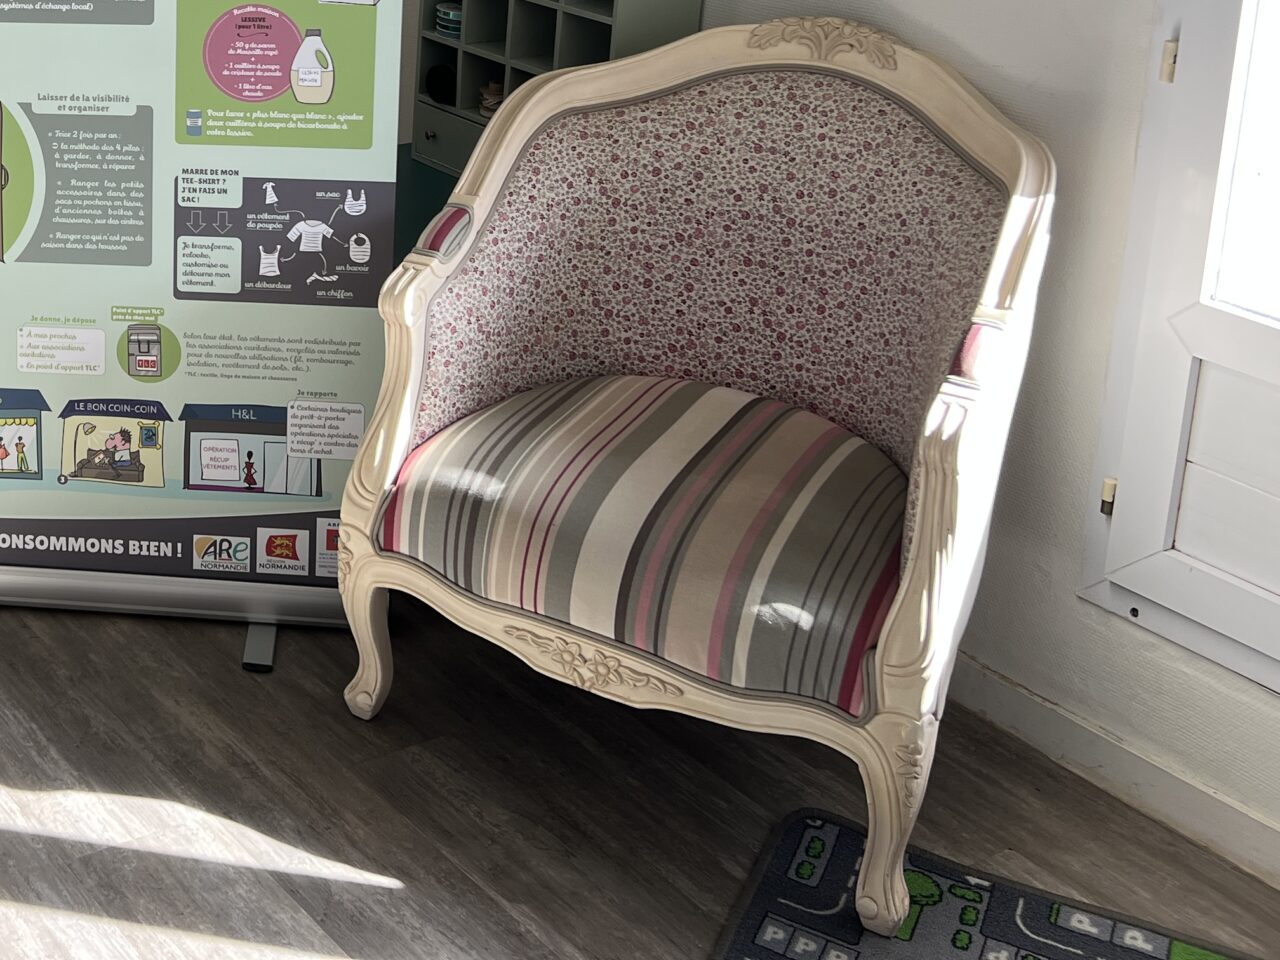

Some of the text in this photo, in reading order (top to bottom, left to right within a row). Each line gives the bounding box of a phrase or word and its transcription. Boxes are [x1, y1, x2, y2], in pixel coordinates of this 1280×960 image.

[37, 93, 130, 103] Laisser de la visibilité
[57, 104, 109, 114] et organiser
[181, 168, 208, 176] MARRE
[181, 196, 196, 204] SAC
[75, 403, 159, 413] LE BON COIN-COIN
[231, 409, 256, 420] H&L
[128, 541, 172, 557] BIEN
[200, 563, 248, 571] NORMANDIE
[258, 563, 305, 572] NORMANDIE
